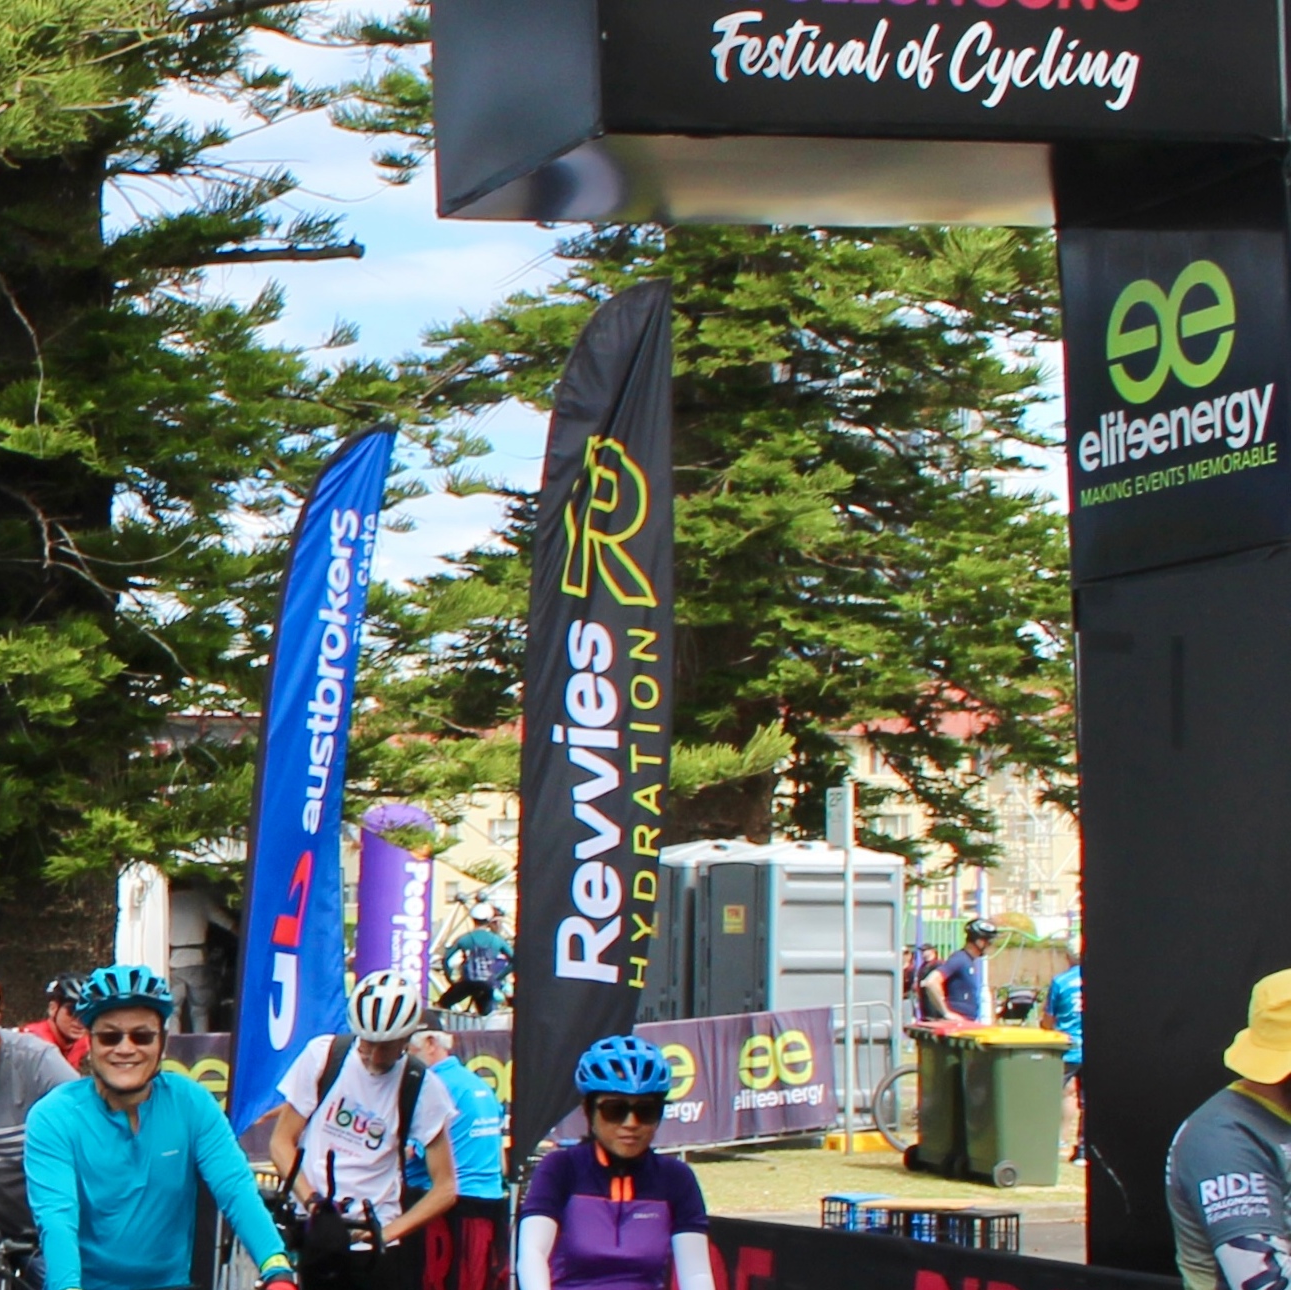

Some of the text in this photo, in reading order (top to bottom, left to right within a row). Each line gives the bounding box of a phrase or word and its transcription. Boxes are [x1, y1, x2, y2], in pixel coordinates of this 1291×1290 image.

[710, 10, 1141, 111] Festival of Cycling
[1080, 442, 1278, 508] MAKING EVENTS MEMORABLE
[302, 508, 360, 836] austbrokers
[551, 619, 623, 985] Revvies
[626, 627, 664, 989] HYDRATION
[391, 861, 430, 990] Peopleca
[1199, 1171, 1268, 1206] RIDE
